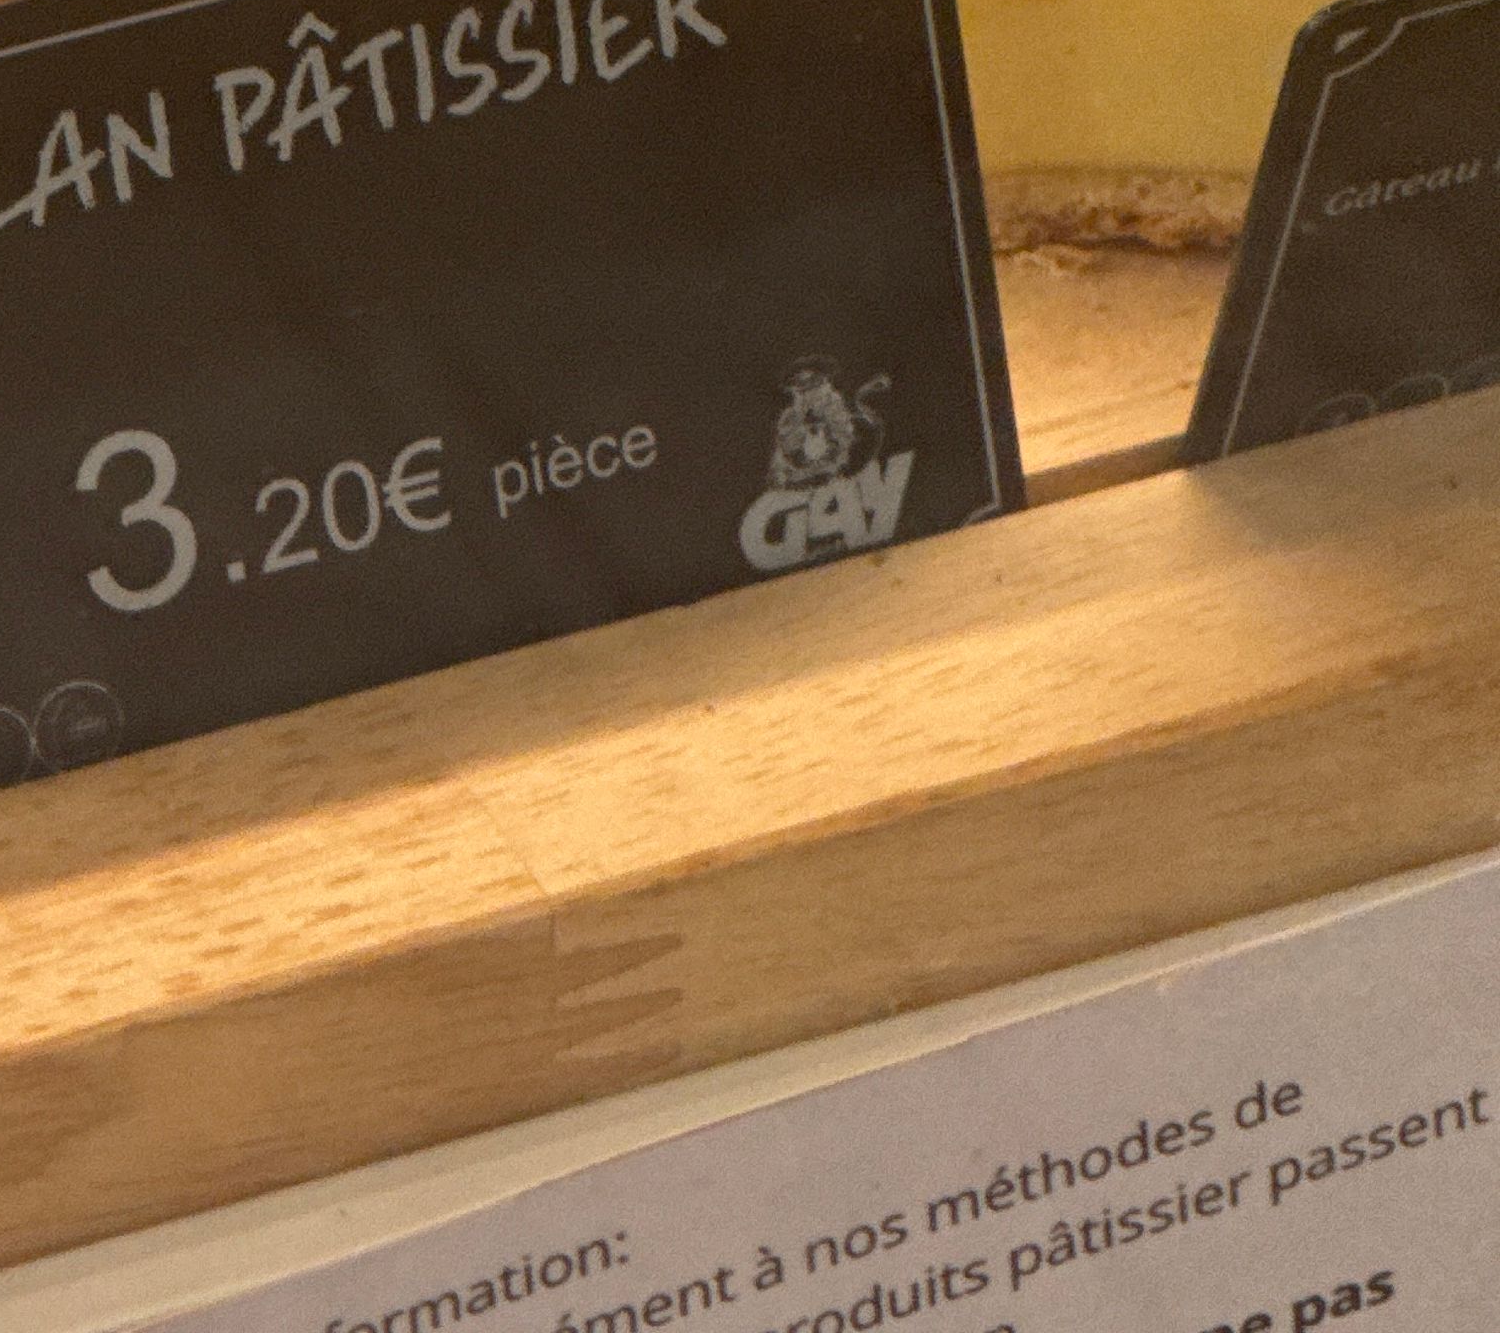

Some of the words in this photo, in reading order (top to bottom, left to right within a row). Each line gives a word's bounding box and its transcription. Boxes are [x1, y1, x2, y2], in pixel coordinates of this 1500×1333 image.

[491, 423, 658, 519] pièce
[753, 1245, 786, 1291] à
[804, 1212, 909, 1274] nos
[925, 1108, 1217, 1235] méthodes
[1235, 1080, 1304, 1130] de
[1007, 1168, 1252, 1292] pâtissier
[1268, 1087, 1491, 1207] passent
[1292, 1270, 1395, 1333] pas
